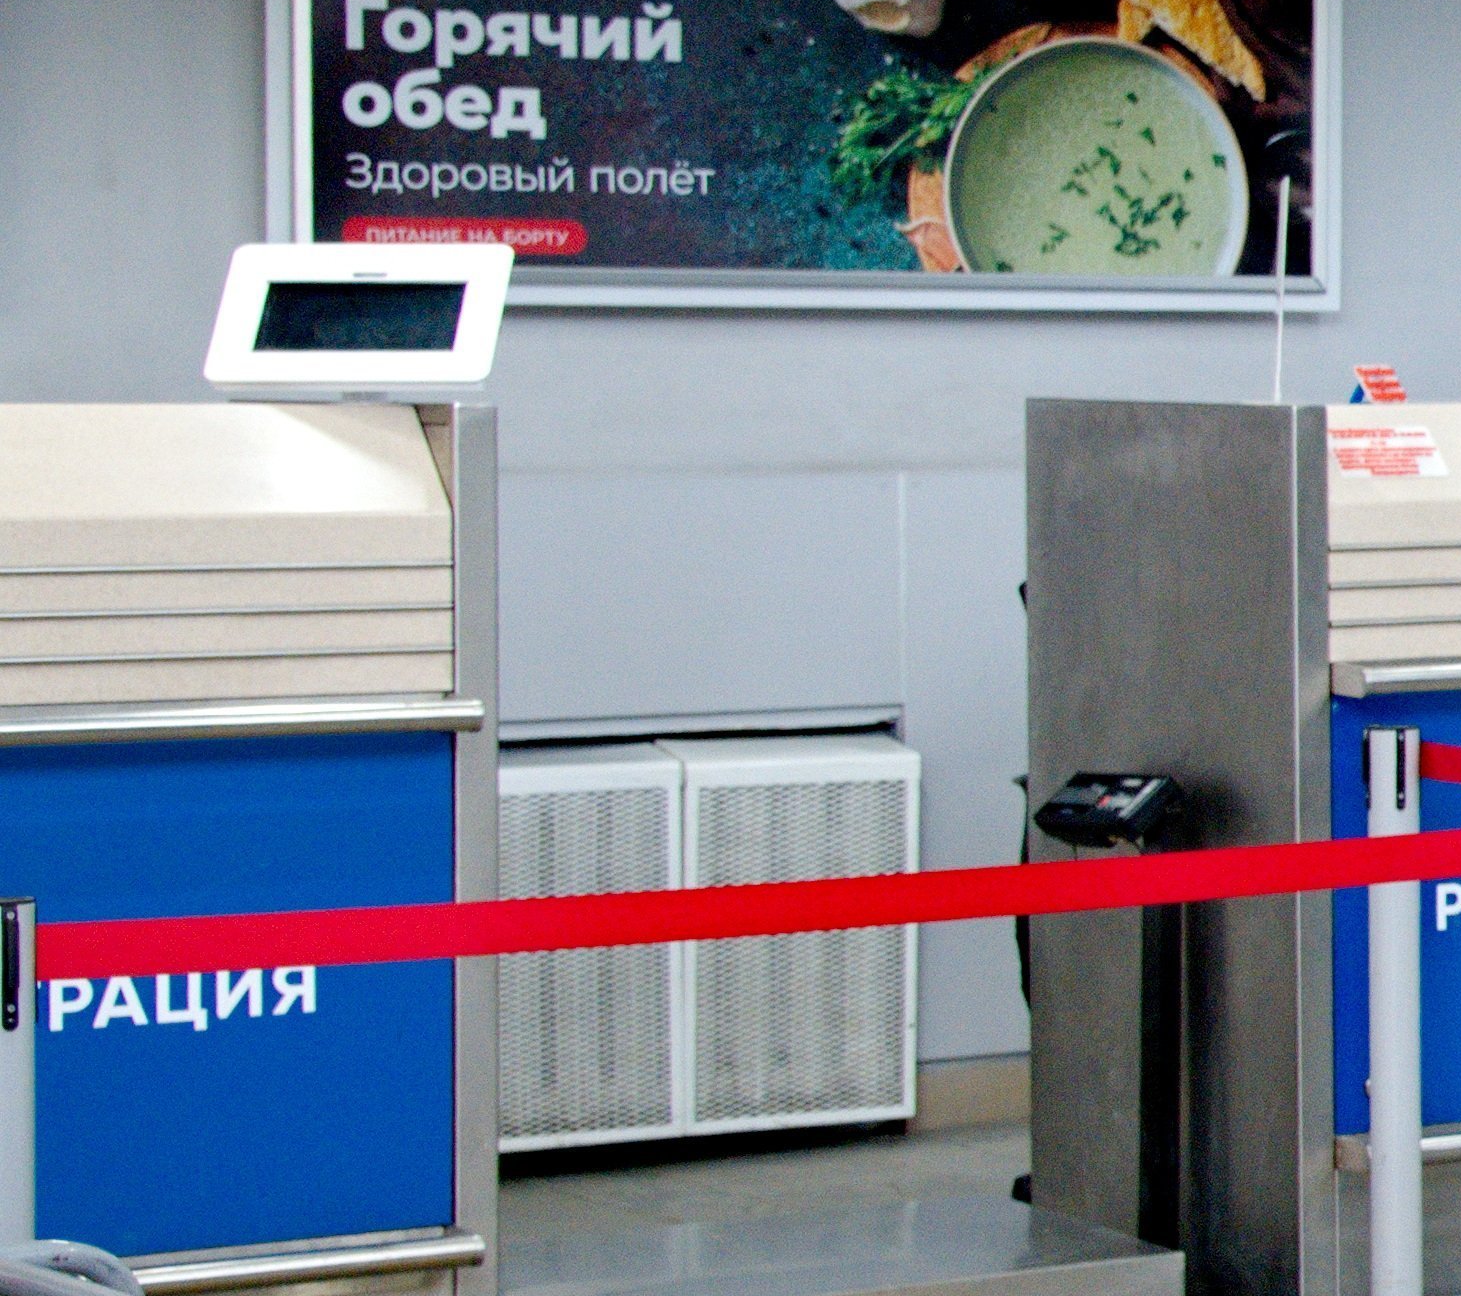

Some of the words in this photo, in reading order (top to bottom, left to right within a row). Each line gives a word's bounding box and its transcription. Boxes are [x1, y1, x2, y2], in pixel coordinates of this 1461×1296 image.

[342, 67, 548, 140] обед
[345, 150, 576, 199] Здоровый
[589, 158, 717, 196] полёт
[502, 226, 570, 247] БОРТУ
[37, 964, 317, 1033] РАЦИЯ
